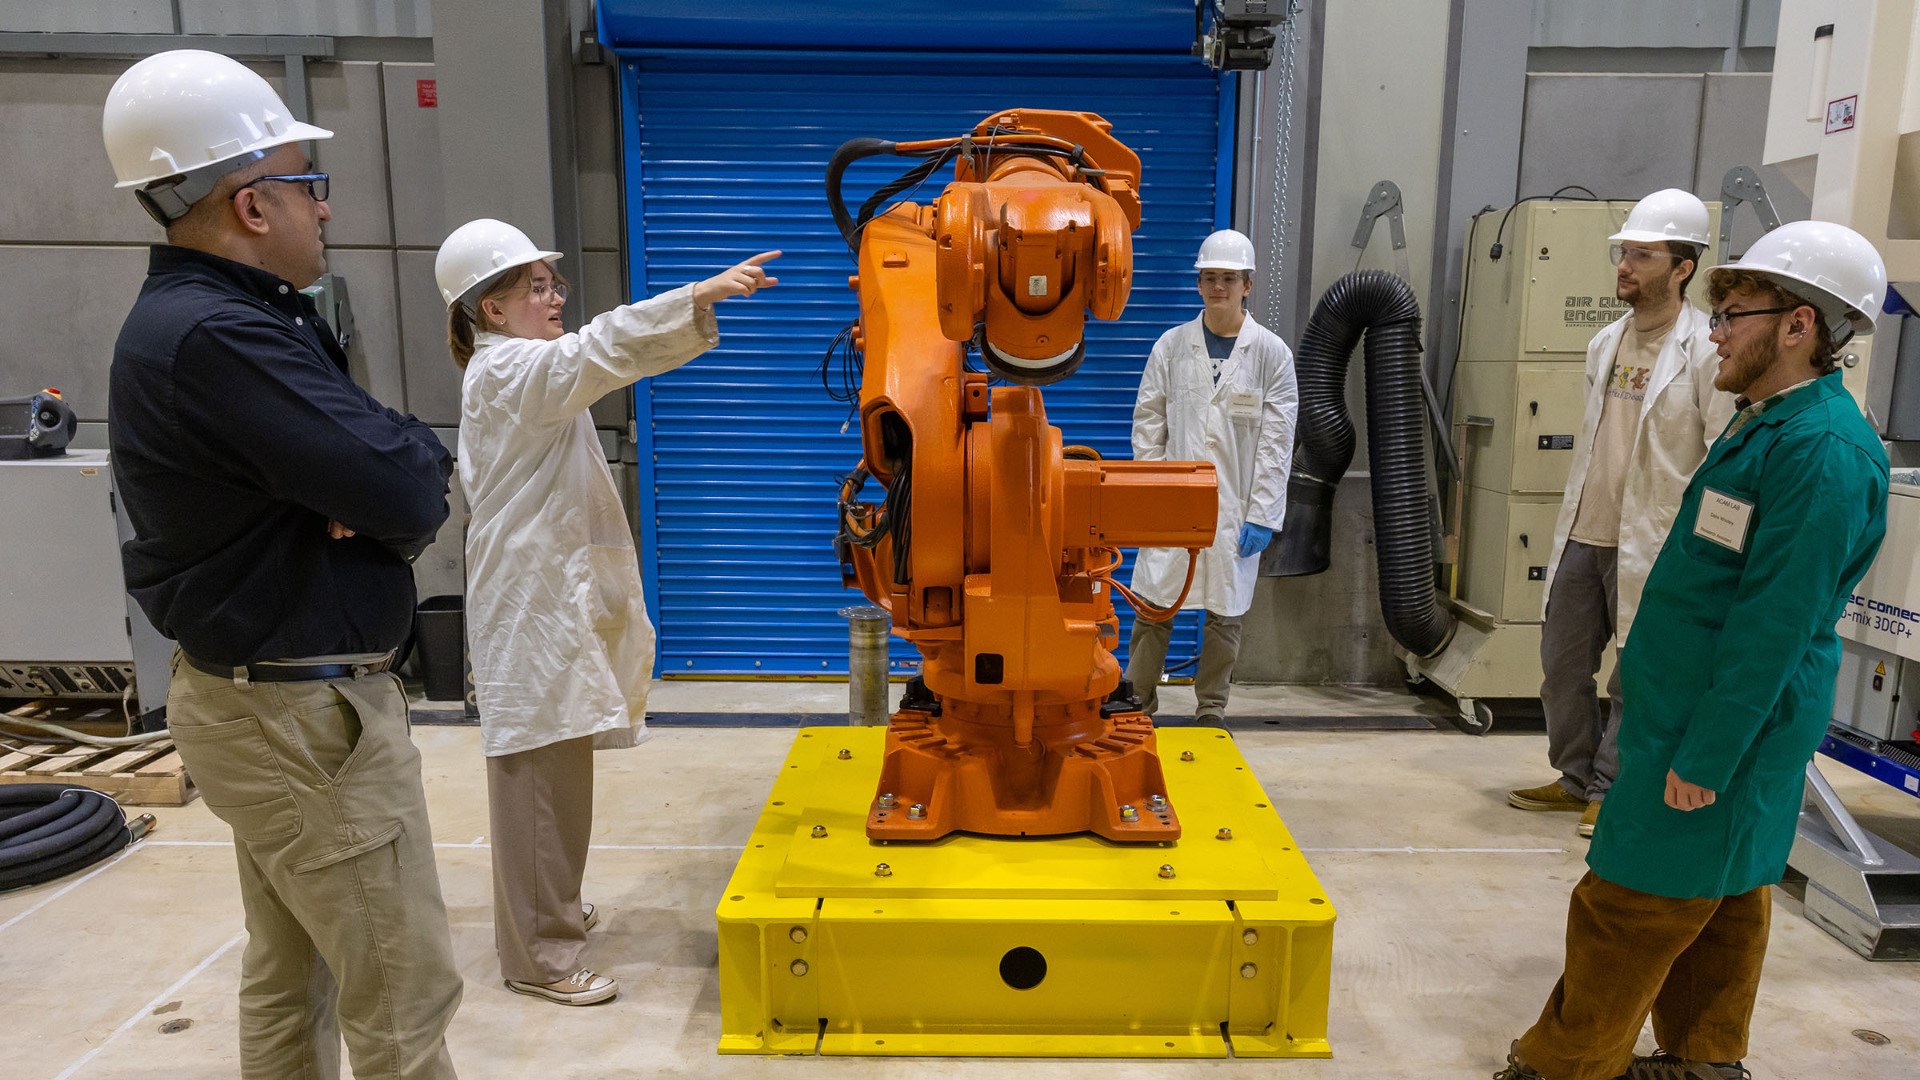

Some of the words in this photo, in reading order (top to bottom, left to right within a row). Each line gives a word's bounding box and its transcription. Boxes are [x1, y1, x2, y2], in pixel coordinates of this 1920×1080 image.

[1565, 297, 1592, 307] AIR
[1730, 502, 1741, 512] LAB
[1874, 615, 1912, 638] 3DCP+
